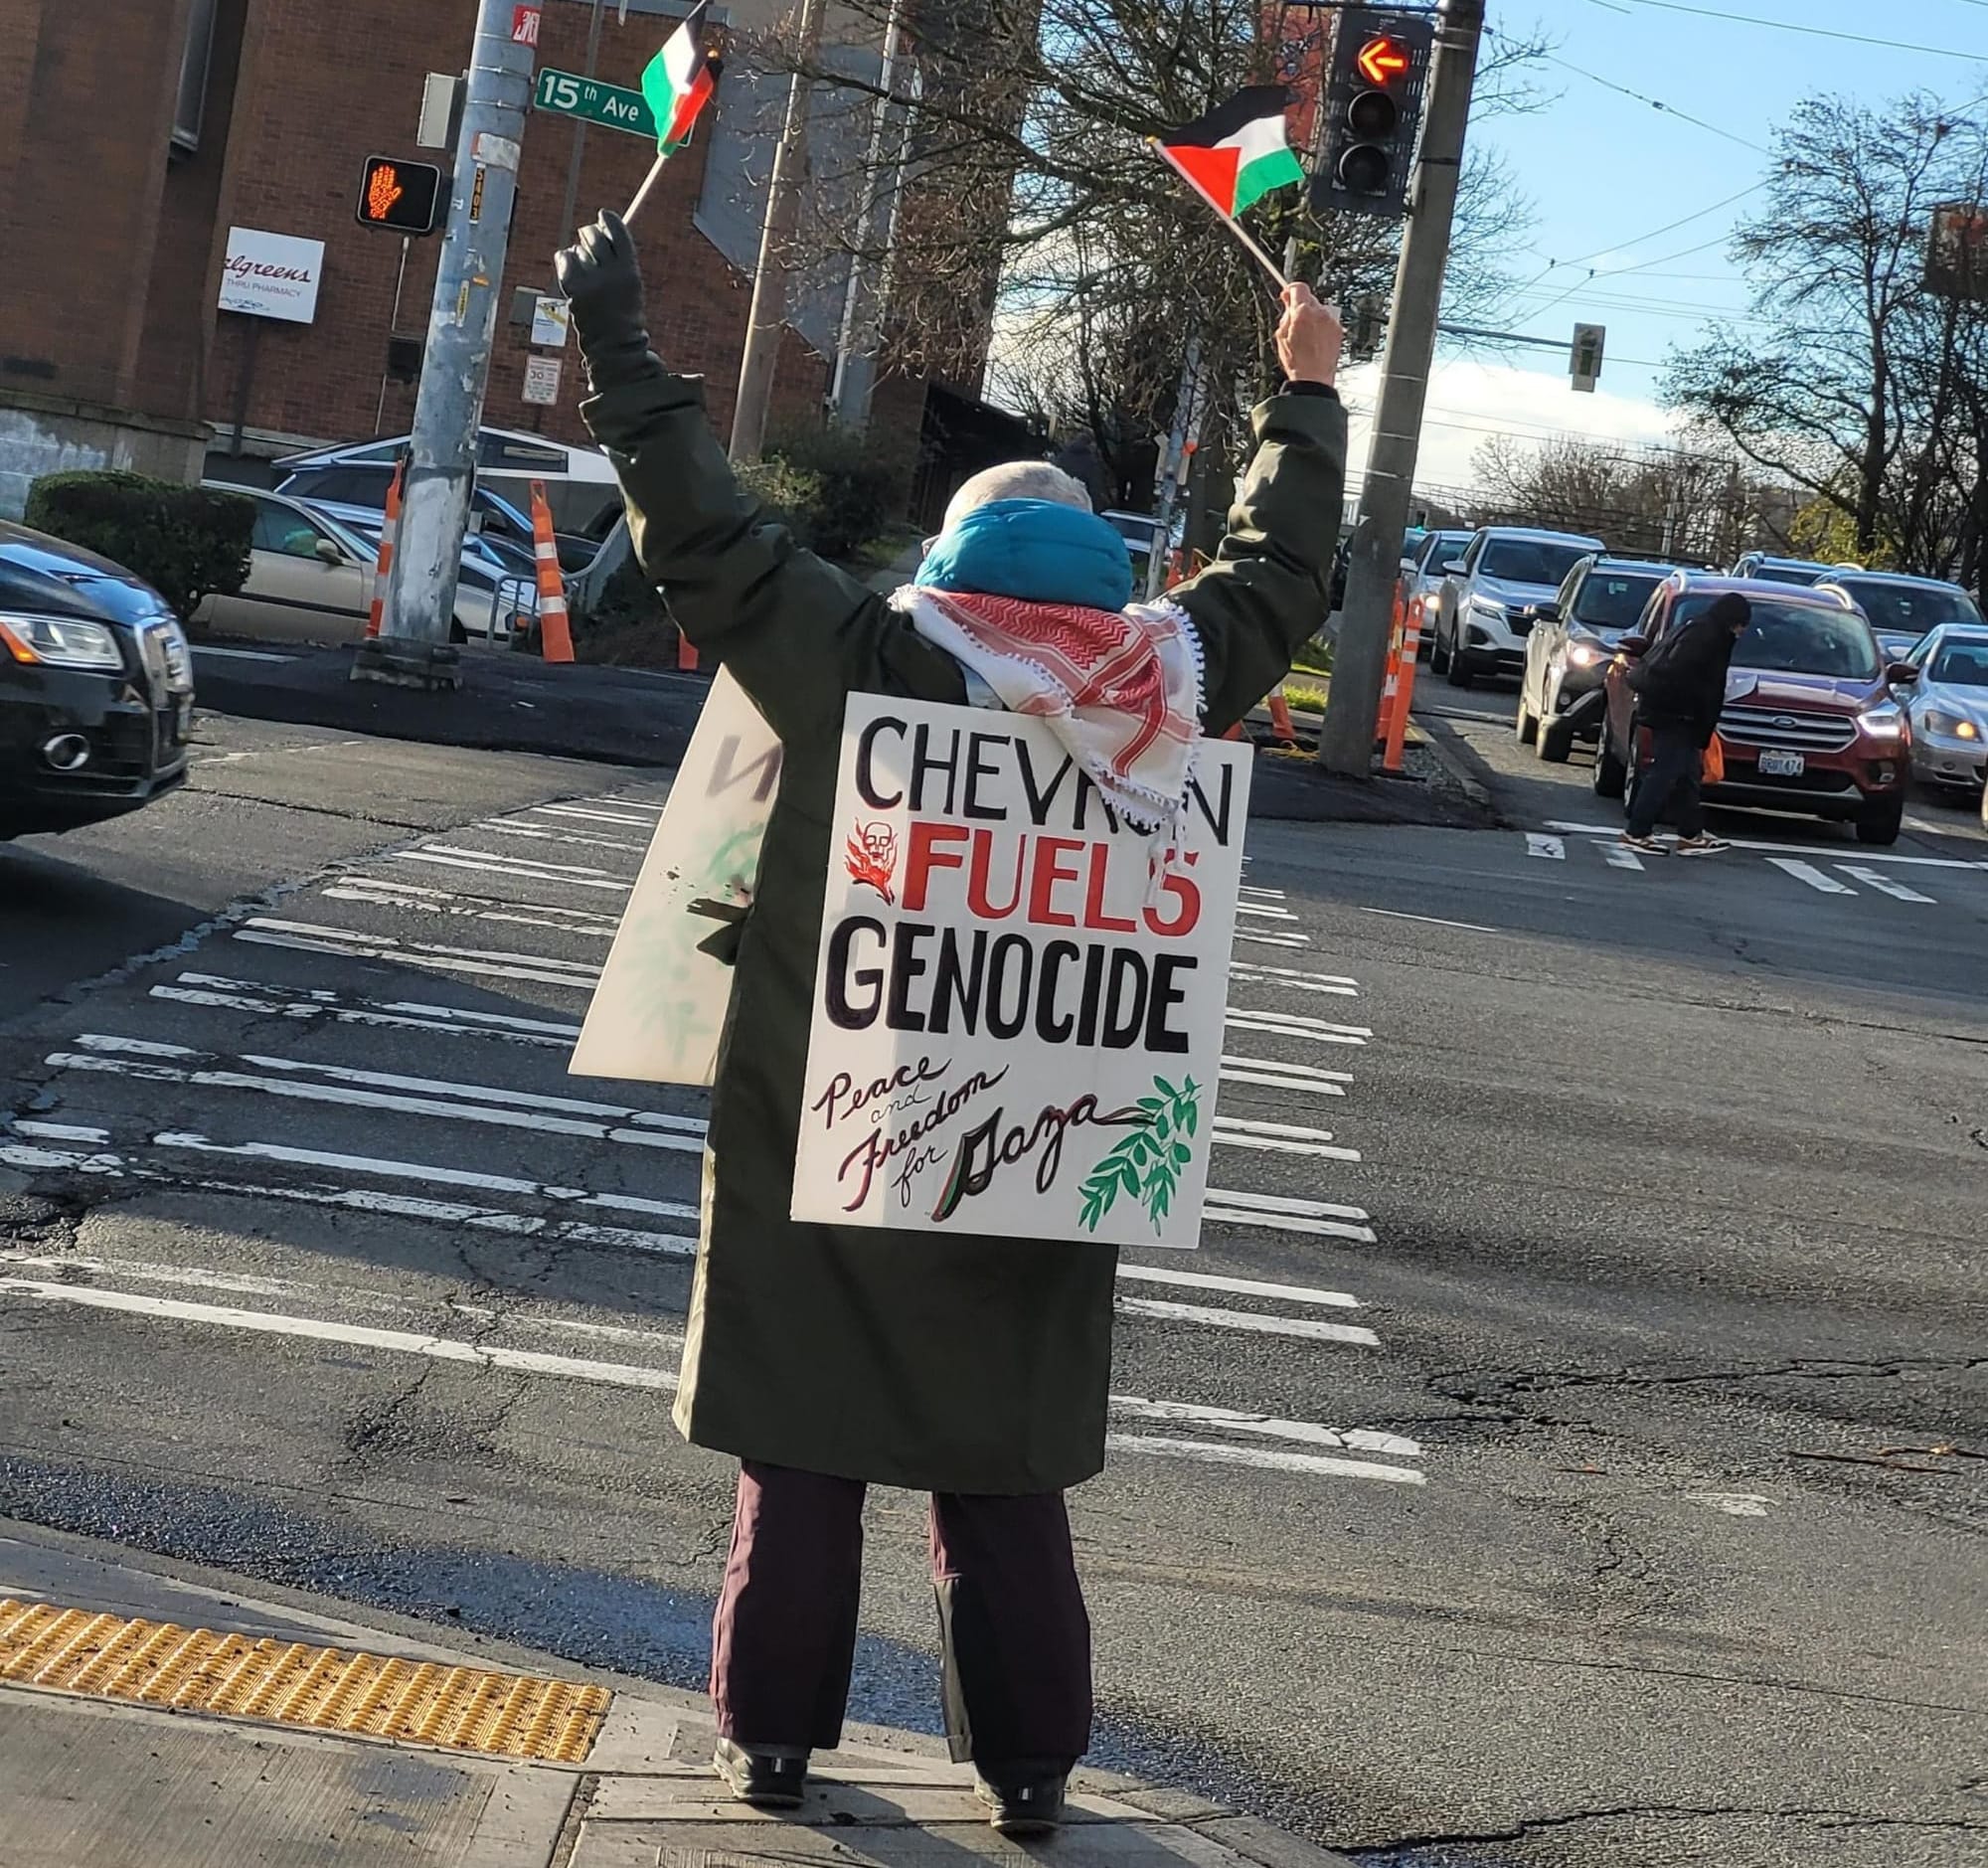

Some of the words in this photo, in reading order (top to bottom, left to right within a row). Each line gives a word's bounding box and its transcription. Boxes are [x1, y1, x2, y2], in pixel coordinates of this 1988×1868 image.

[602, 96, 639, 121] Ave
[251, 281, 301, 297] PHARMACY
[901, 820, 1202, 937] FUELS
[824, 915, 1198, 1054] GENOCIDE
[811, 1056, 952, 1130] Peace
[837, 1064, 1010, 1212] Freedom
[870, 1084, 932, 1124] and
[891, 1144, 948, 1208] for
[930, 1094, 1118, 1223] Gaza
